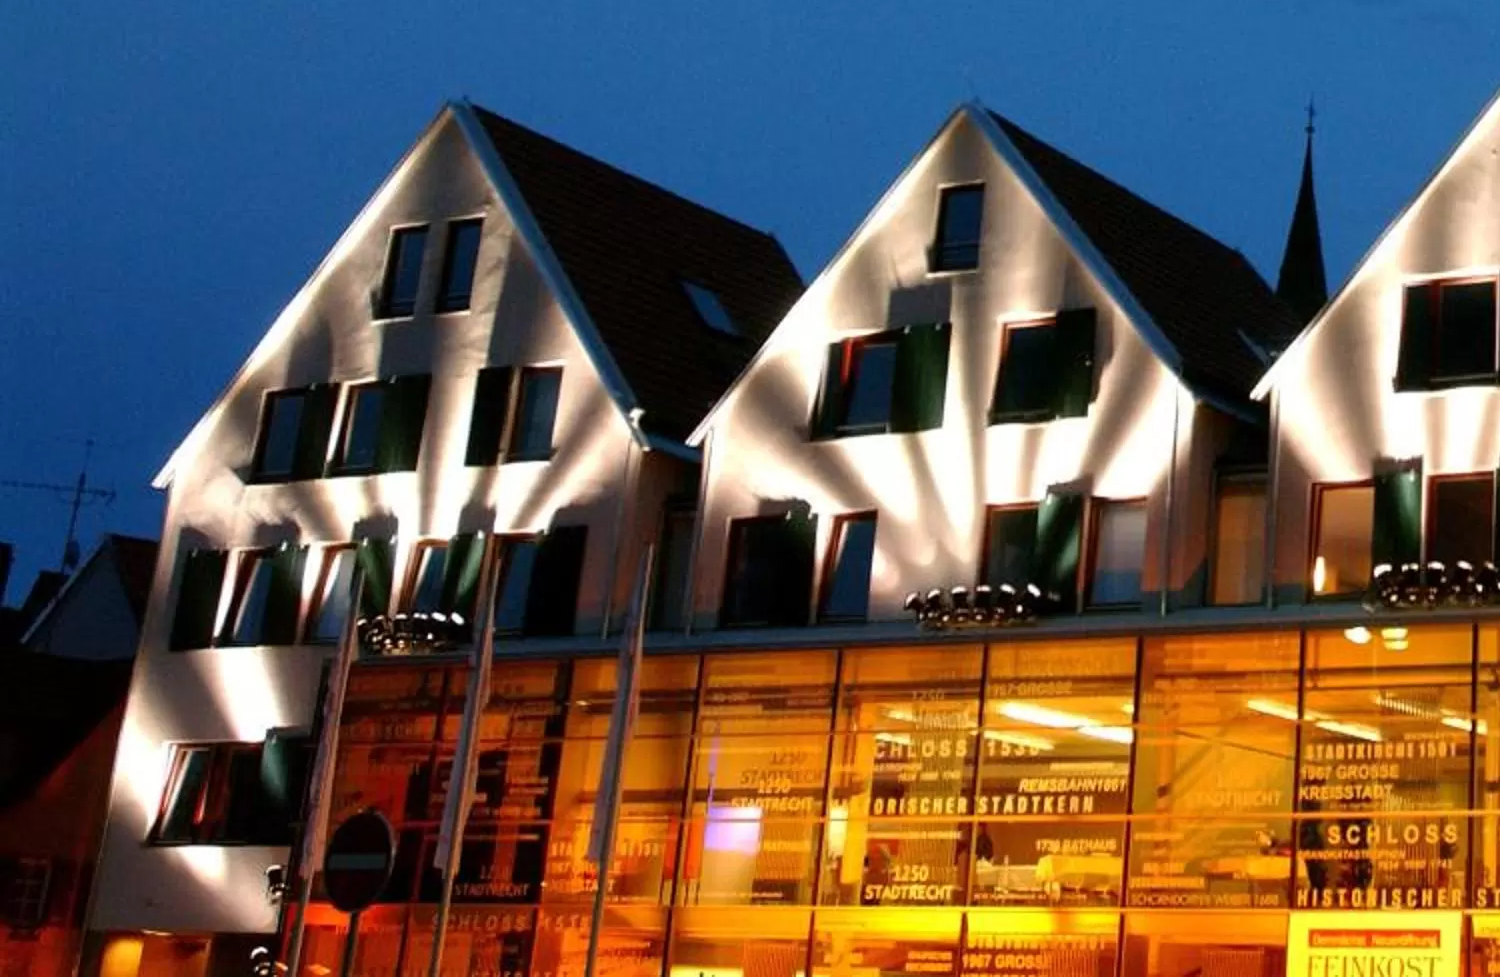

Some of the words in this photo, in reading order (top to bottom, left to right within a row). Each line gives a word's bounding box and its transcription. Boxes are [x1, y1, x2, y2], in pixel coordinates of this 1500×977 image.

[1336, 763, 1400, 780] GROSSE
[1299, 783, 1394, 800] KREISSTADT
[975, 795, 1094, 815] STADTKERN
[1327, 824, 1459, 844] SCHLOSS
[892, 863, 930, 882] 1250
[864, 884, 954, 900] STADTRECHT
[1297, 887, 1462, 908] HISTORISCHER
[1308, 955, 1443, 977] FEINKOST
